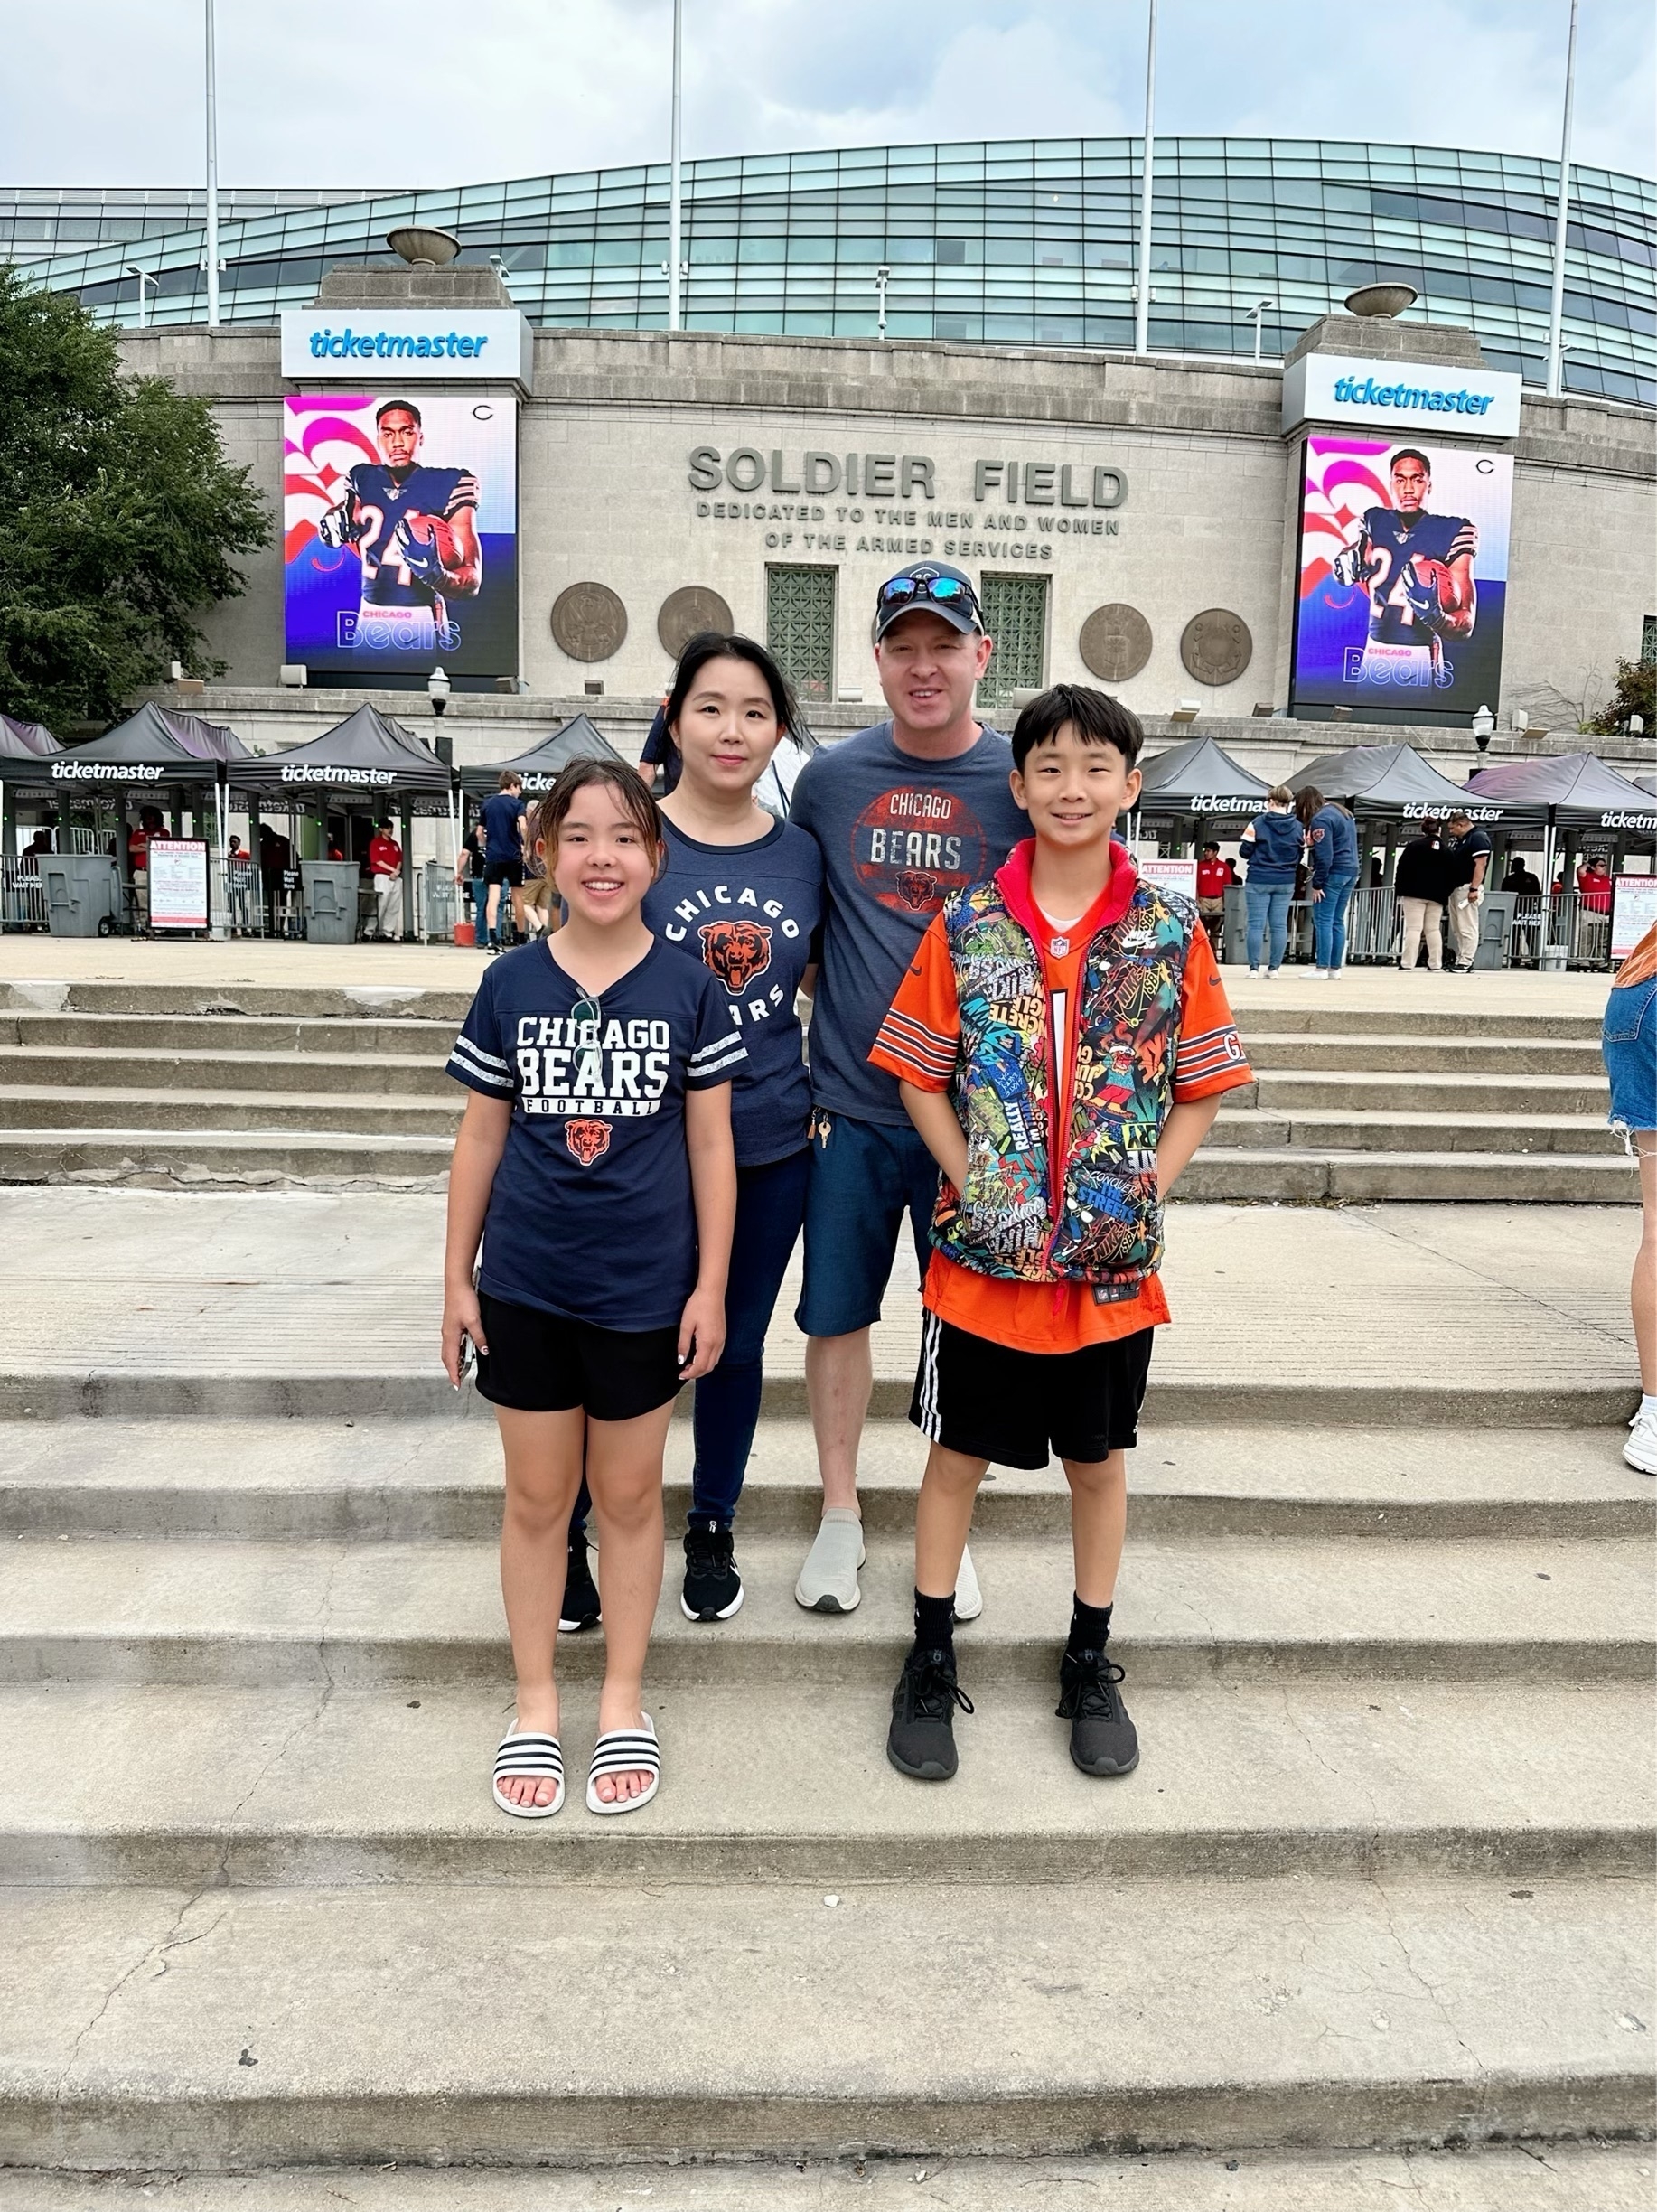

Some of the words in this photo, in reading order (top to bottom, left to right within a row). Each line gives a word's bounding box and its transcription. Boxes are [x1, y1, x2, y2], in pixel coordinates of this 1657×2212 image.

[310, 329, 488, 357] ticketmaster
[1334, 376, 1495, 415] ticketmaster
[688, 445, 935, 500] SOLDIER
[975, 459, 1128, 508] FIELD
[697, 501, 826, 521] DEDICATED
[836, 506, 865, 523] TO
[875, 508, 916, 526] THE
[928, 511, 974, 528] MEN
[984, 513, 1028, 530] AND
[1038, 516, 1119, 535] WOMEN
[359, 504, 420, 587] 24
[765, 531, 793, 548] OF
[804, 533, 846, 550] THE
[857, 536, 934, 554] ARMED
[944, 539, 1053, 559] SERVICES
[1367, 547, 1425, 626] 24
[336, 611, 462, 651] Bears
[362, 611, 412, 619] CHICAGO
[1343, 646, 1455, 689] Bears
[1368, 648, 1412, 657] CHICAGO
[51, 760, 164, 780] ticketmaster
[280, 764, 398, 785] ticketmaster
[890, 793, 952, 820] CHICAGO
[150, 840, 206, 851] ATTENTION
[870, 828, 961, 870] BEARS
[1142, 865, 1193, 874] ATTENTION
[665, 885, 800, 942] CHICAGO
[516, 1017, 669, 1050] CHICAGO
[516, 1048, 670, 1098] BEARS
[527, 1099, 653, 1115] FOOTBALL
[1004, 1101, 1030, 1151] REALLY
[1089, 1171, 1137, 1195] CONQUER
[1101, 1182, 1124, 1203] THE
[1078, 1186, 1136, 1225] STREETS
